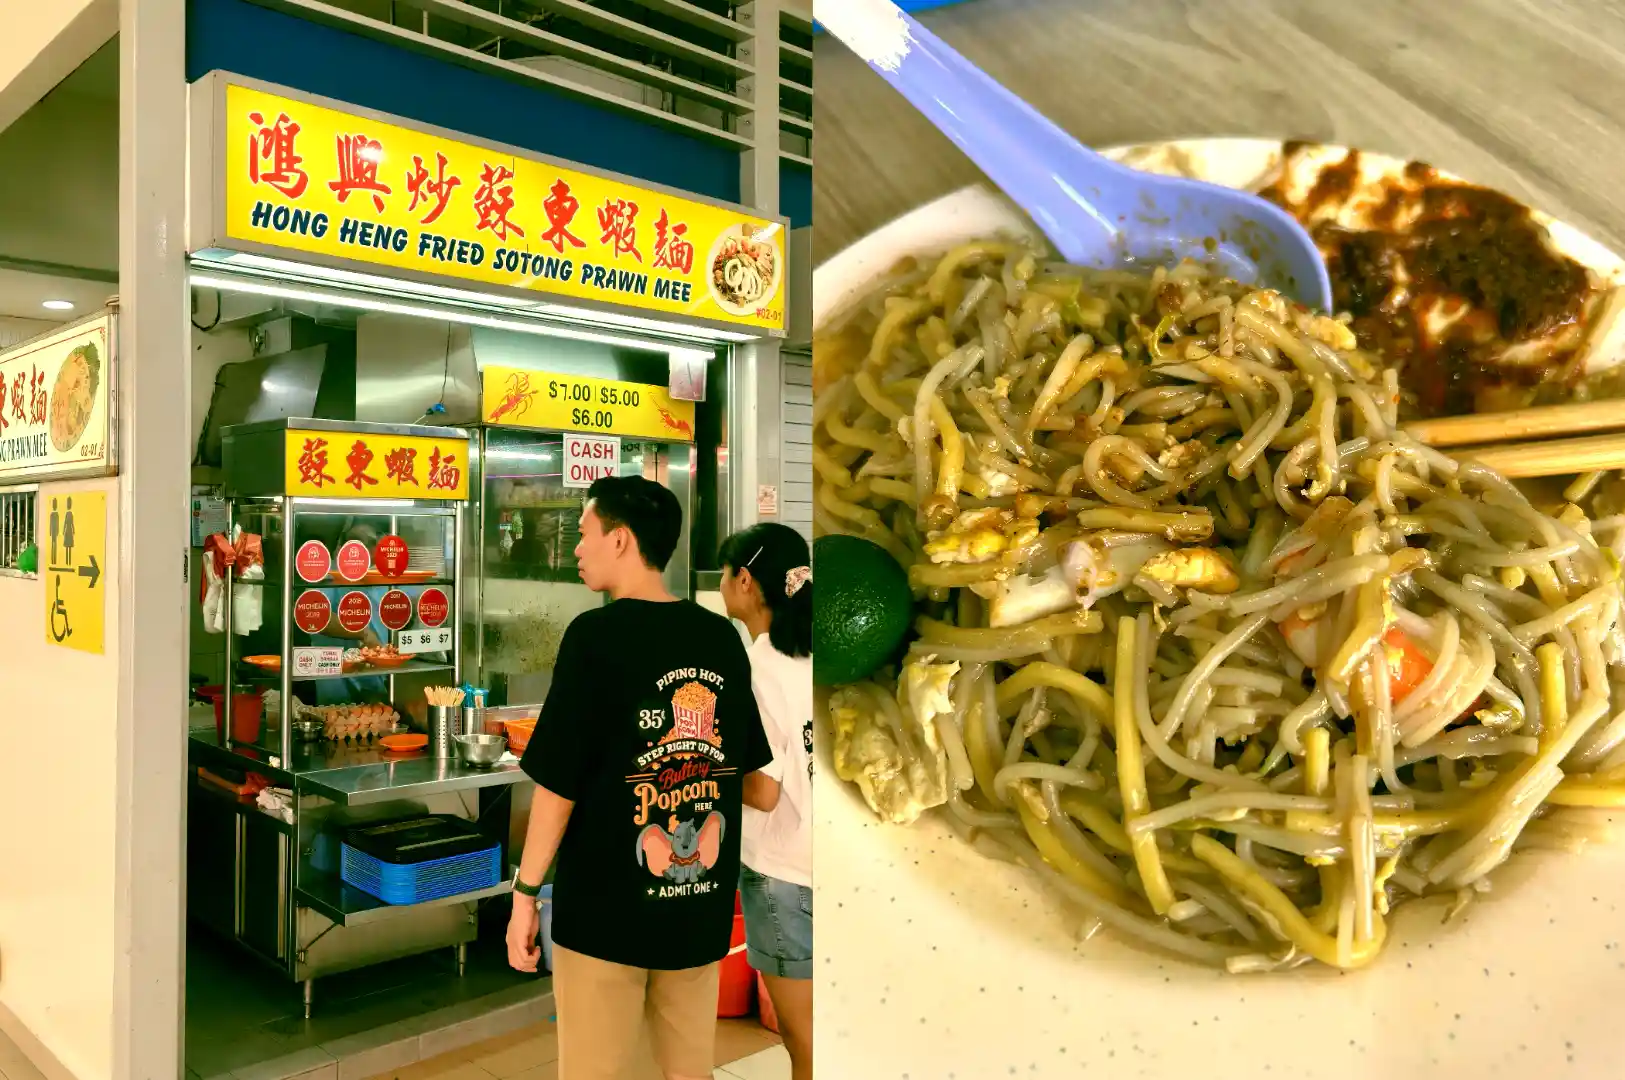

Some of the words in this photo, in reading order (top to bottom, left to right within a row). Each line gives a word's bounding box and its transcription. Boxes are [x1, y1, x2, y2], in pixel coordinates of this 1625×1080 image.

[251, 201, 329, 238] HONG
[339, 218, 408, 252] HENG
[419, 233, 484, 266] FRIED
[493, 248, 573, 281] SOTONG
[581, 264, 648, 294] PRAWN
[654, 278, 692, 303] MEE
[549, 380, 591, 402] $7.00
[600, 386, 640, 407] $5.00
[572, 408, 613, 428] $6.00
[8, 436, 31, 461] PRAWN
[33, 432, 47, 457] MEE
[571, 441, 614, 460] CASH
[298, 437, 460, 491] 蘇東蝦麵
[571, 464, 614, 481] ONLY
[298, 602, 329, 610] MICHELIN
[340, 608, 371, 616] MICHELIN
[401, 634, 413, 646] $5
[420, 633, 431, 645] $6
[438, 633, 449, 644] $7
[656, 667, 697, 691] PIPING
[700, 668, 724, 690] HOT,
[637, 747, 665, 766] STEP
[666, 740, 697, 754] RIGHT
[698, 742, 710, 753] UP
[709, 746, 725, 763] FOR
[633, 780, 720, 825] Popcorn
[695, 802, 713, 811] HERE
[659, 884, 692, 898] ADMIT
[694, 881, 711, 894] ONE
